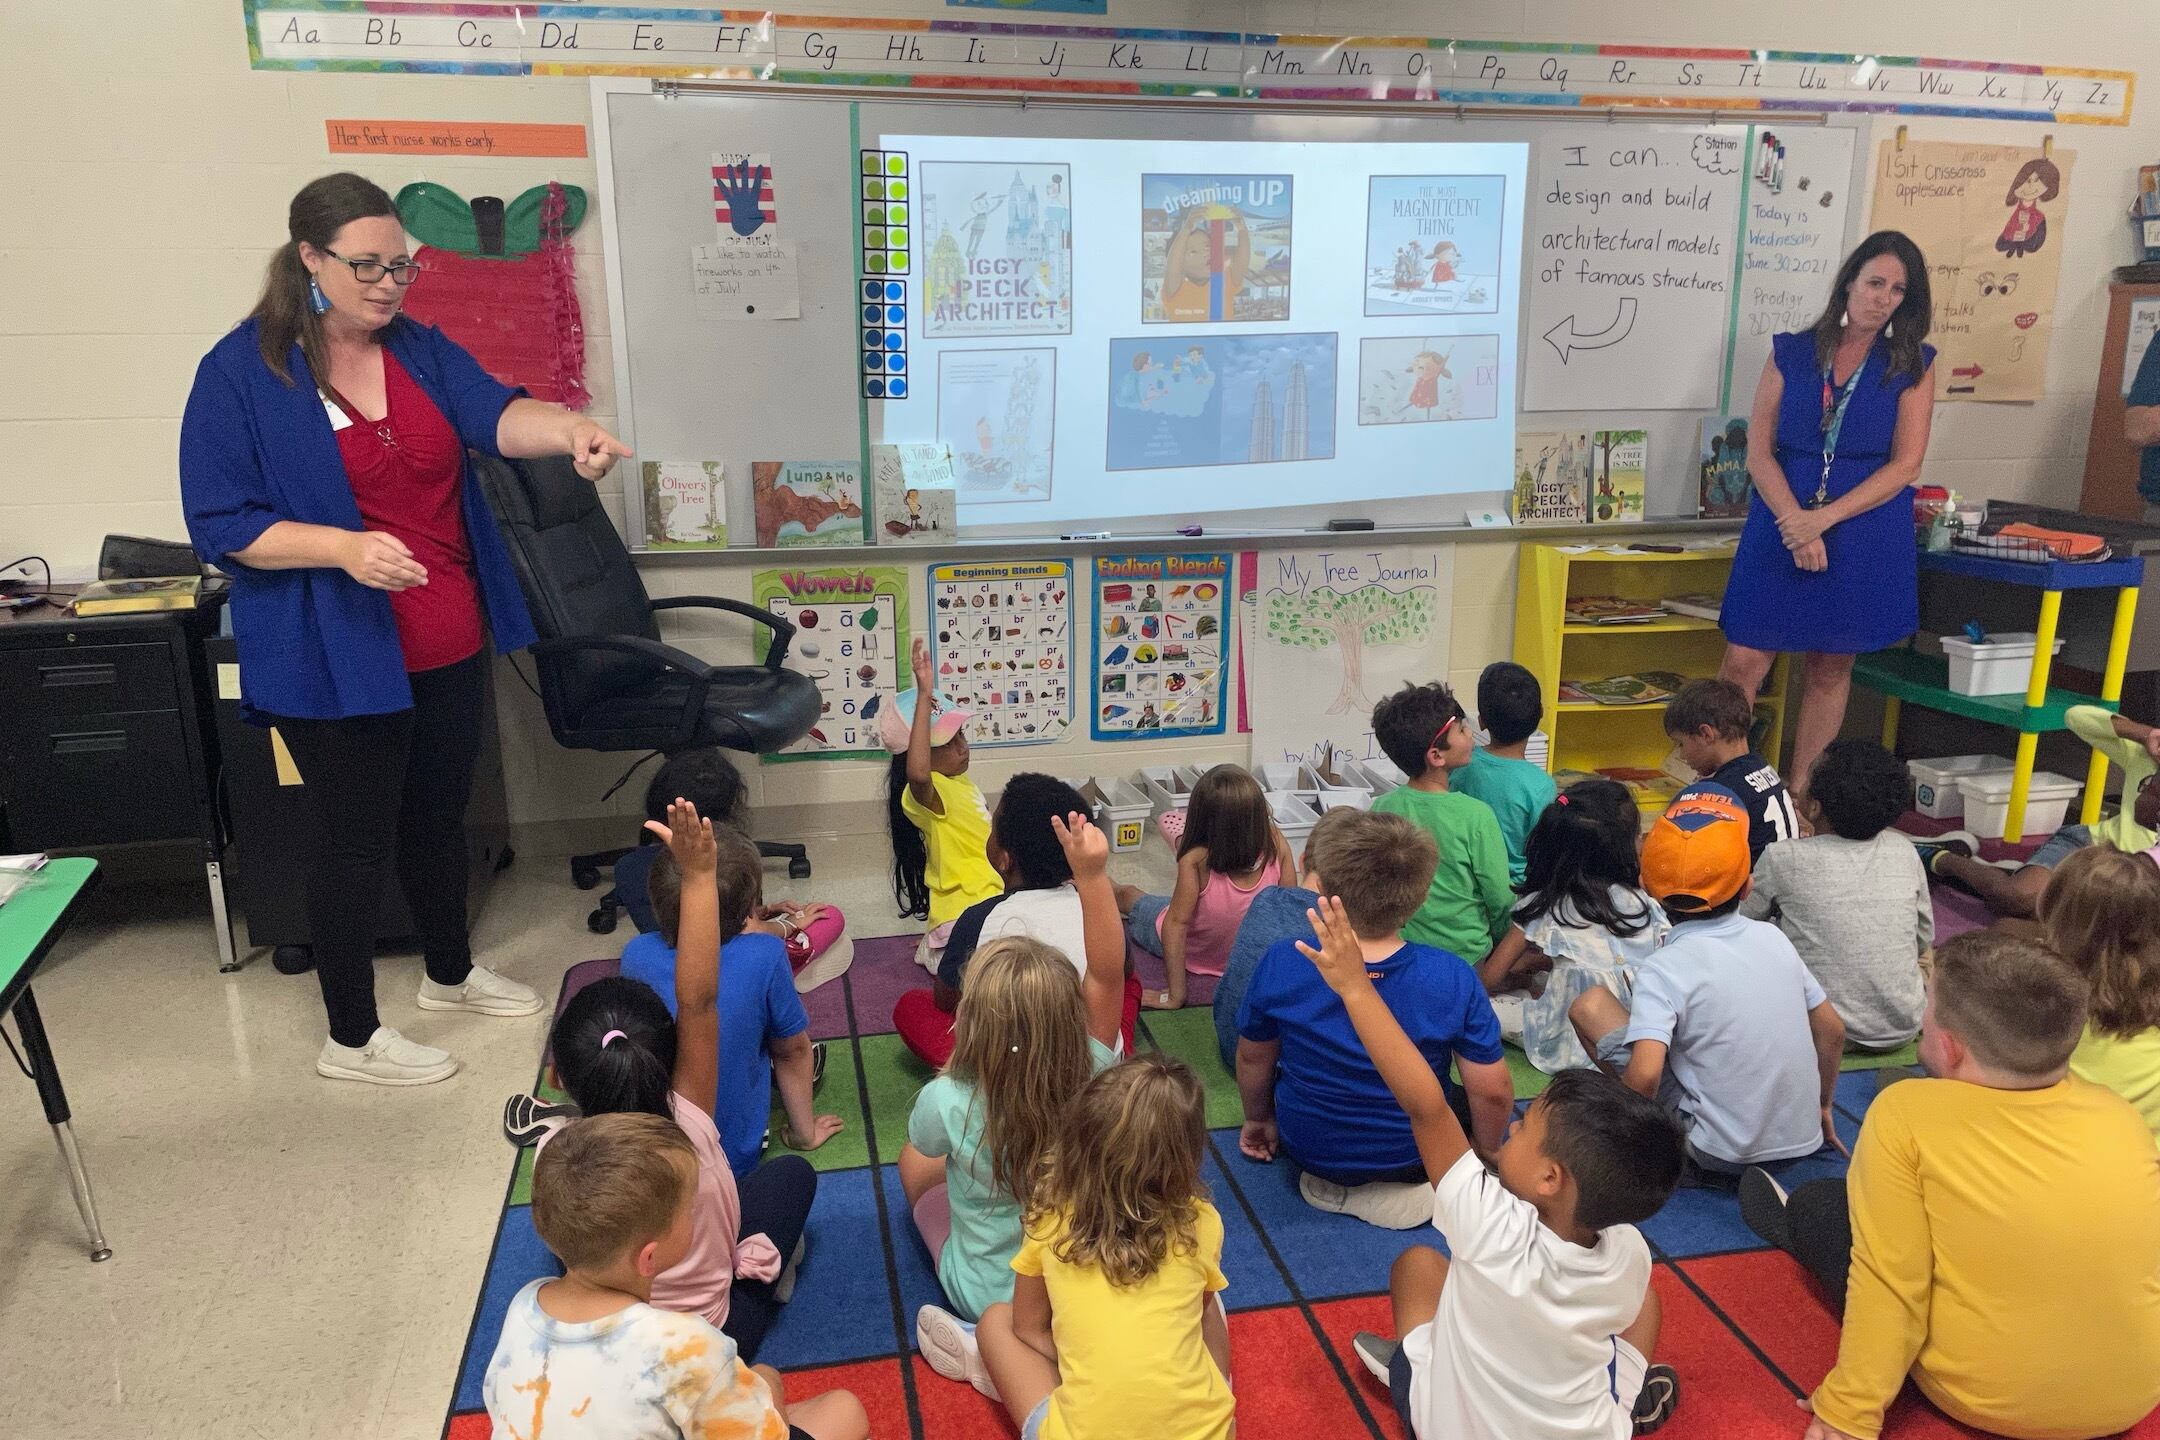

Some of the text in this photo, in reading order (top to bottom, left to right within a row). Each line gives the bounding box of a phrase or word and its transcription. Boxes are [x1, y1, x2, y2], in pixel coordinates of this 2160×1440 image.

[280, 18, 320, 44] Aa
[365, 19, 402, 46] Bb
[457, 20, 493, 48] Cc
[540, 22, 578, 49] Dd
[632, 24, 665, 51] Ee
[715, 26, 751, 53] Ff
[804, 32, 838, 70] Gg
[886, 35, 924, 62] Hh
[964, 37, 985, 64] Ii
[1039, 41, 1067, 77] Jj
[1109, 43, 1143, 69] Kk
[1185, 45, 1209, 71] Ll
[1261, 50, 1304, 75] Mm
[1337, 52, 1373, 76] Nn
[1480, 56, 1506, 90] Pp
[1540, 58, 1568, 91] Qq
[1609, 61, 1636, 84] Rr
[1677, 63, 1702, 86] Ss
[1739, 64, 1763, 87] Tt
[1800, 67, 1827, 90] Uu
[1867, 69, 1890, 92] Vv
[1919, 72, 1953, 95] Ww
[1979, 75, 2007, 98] Xx
[2044, 80, 2063, 110] Yy
[2086, 83, 2108, 105] Zz
[334, 126, 359, 145] Her
[363, 126, 388, 145] first
[393, 134, 424, 146] nurse
[430, 131, 462, 146] works
[1705, 136, 1738, 151] Station
[1563, 146, 1589, 167] I
[1711, 151, 1722, 164] 1
[1162, 179, 1284, 214] dreaming UP
[1546, 180, 1712, 215] design and build
[1393, 198, 1481, 217] MAGNIFICENT
[1753, 204, 1808, 226] Today is
[1416, 218, 1455, 236] THING
[1541, 225, 1721, 256] architectural models
[1750, 229, 1821, 248] Wednesday
[700, 247, 786, 260] I like to watch
[697, 265, 743, 277] fireworks
[968, 258, 1024, 275] IGGY
[1744, 253, 1769, 270] June
[1792, 258, 1829, 274] 2021
[1541, 258, 1564, 283] of
[1576, 258, 1645, 287] famous
[715, 281, 741, 296] July!
[934, 300, 1058, 322] ARCHITECT
[1623, 451, 1642, 459] TREE
[1706, 460, 1740, 476] MAMA
[662, 476, 706, 491] Oliver's
[786, 469, 823, 483] Luna
[835, 472, 853, 484] Me
[1537, 483, 1565, 493] IGGY
[680, 491, 704, 504] Tree
[1520, 507, 1580, 519] ARCHITECT
[953, 566, 1048, 577] Beginning Blends
[1097, 556, 1226, 579] Ending Blends
[779, 571, 876, 596] Vowels
[1278, 553, 1437, 599] My Tree Journal
[947, 580, 1055, 593] bl cl fl gl
[1125, 602, 1136, 611] nk
[1185, 600, 1194, 610] sh
[948, 617, 957, 628] pl
[982, 616, 990, 625] sl
[1014, 614, 1024, 623] br
[1127, 630, 1194, 641] ck nd
[948, 647, 1057, 659] dr fr gr pr
[1185, 660, 1195, 668] ch
[951, 683, 959, 691] tr
[982, 681, 993, 689] sk
[1126, 690, 1134, 699] th
[1122, 720, 1133, 729] ng
[1123, 829, 1136, 840] 10
